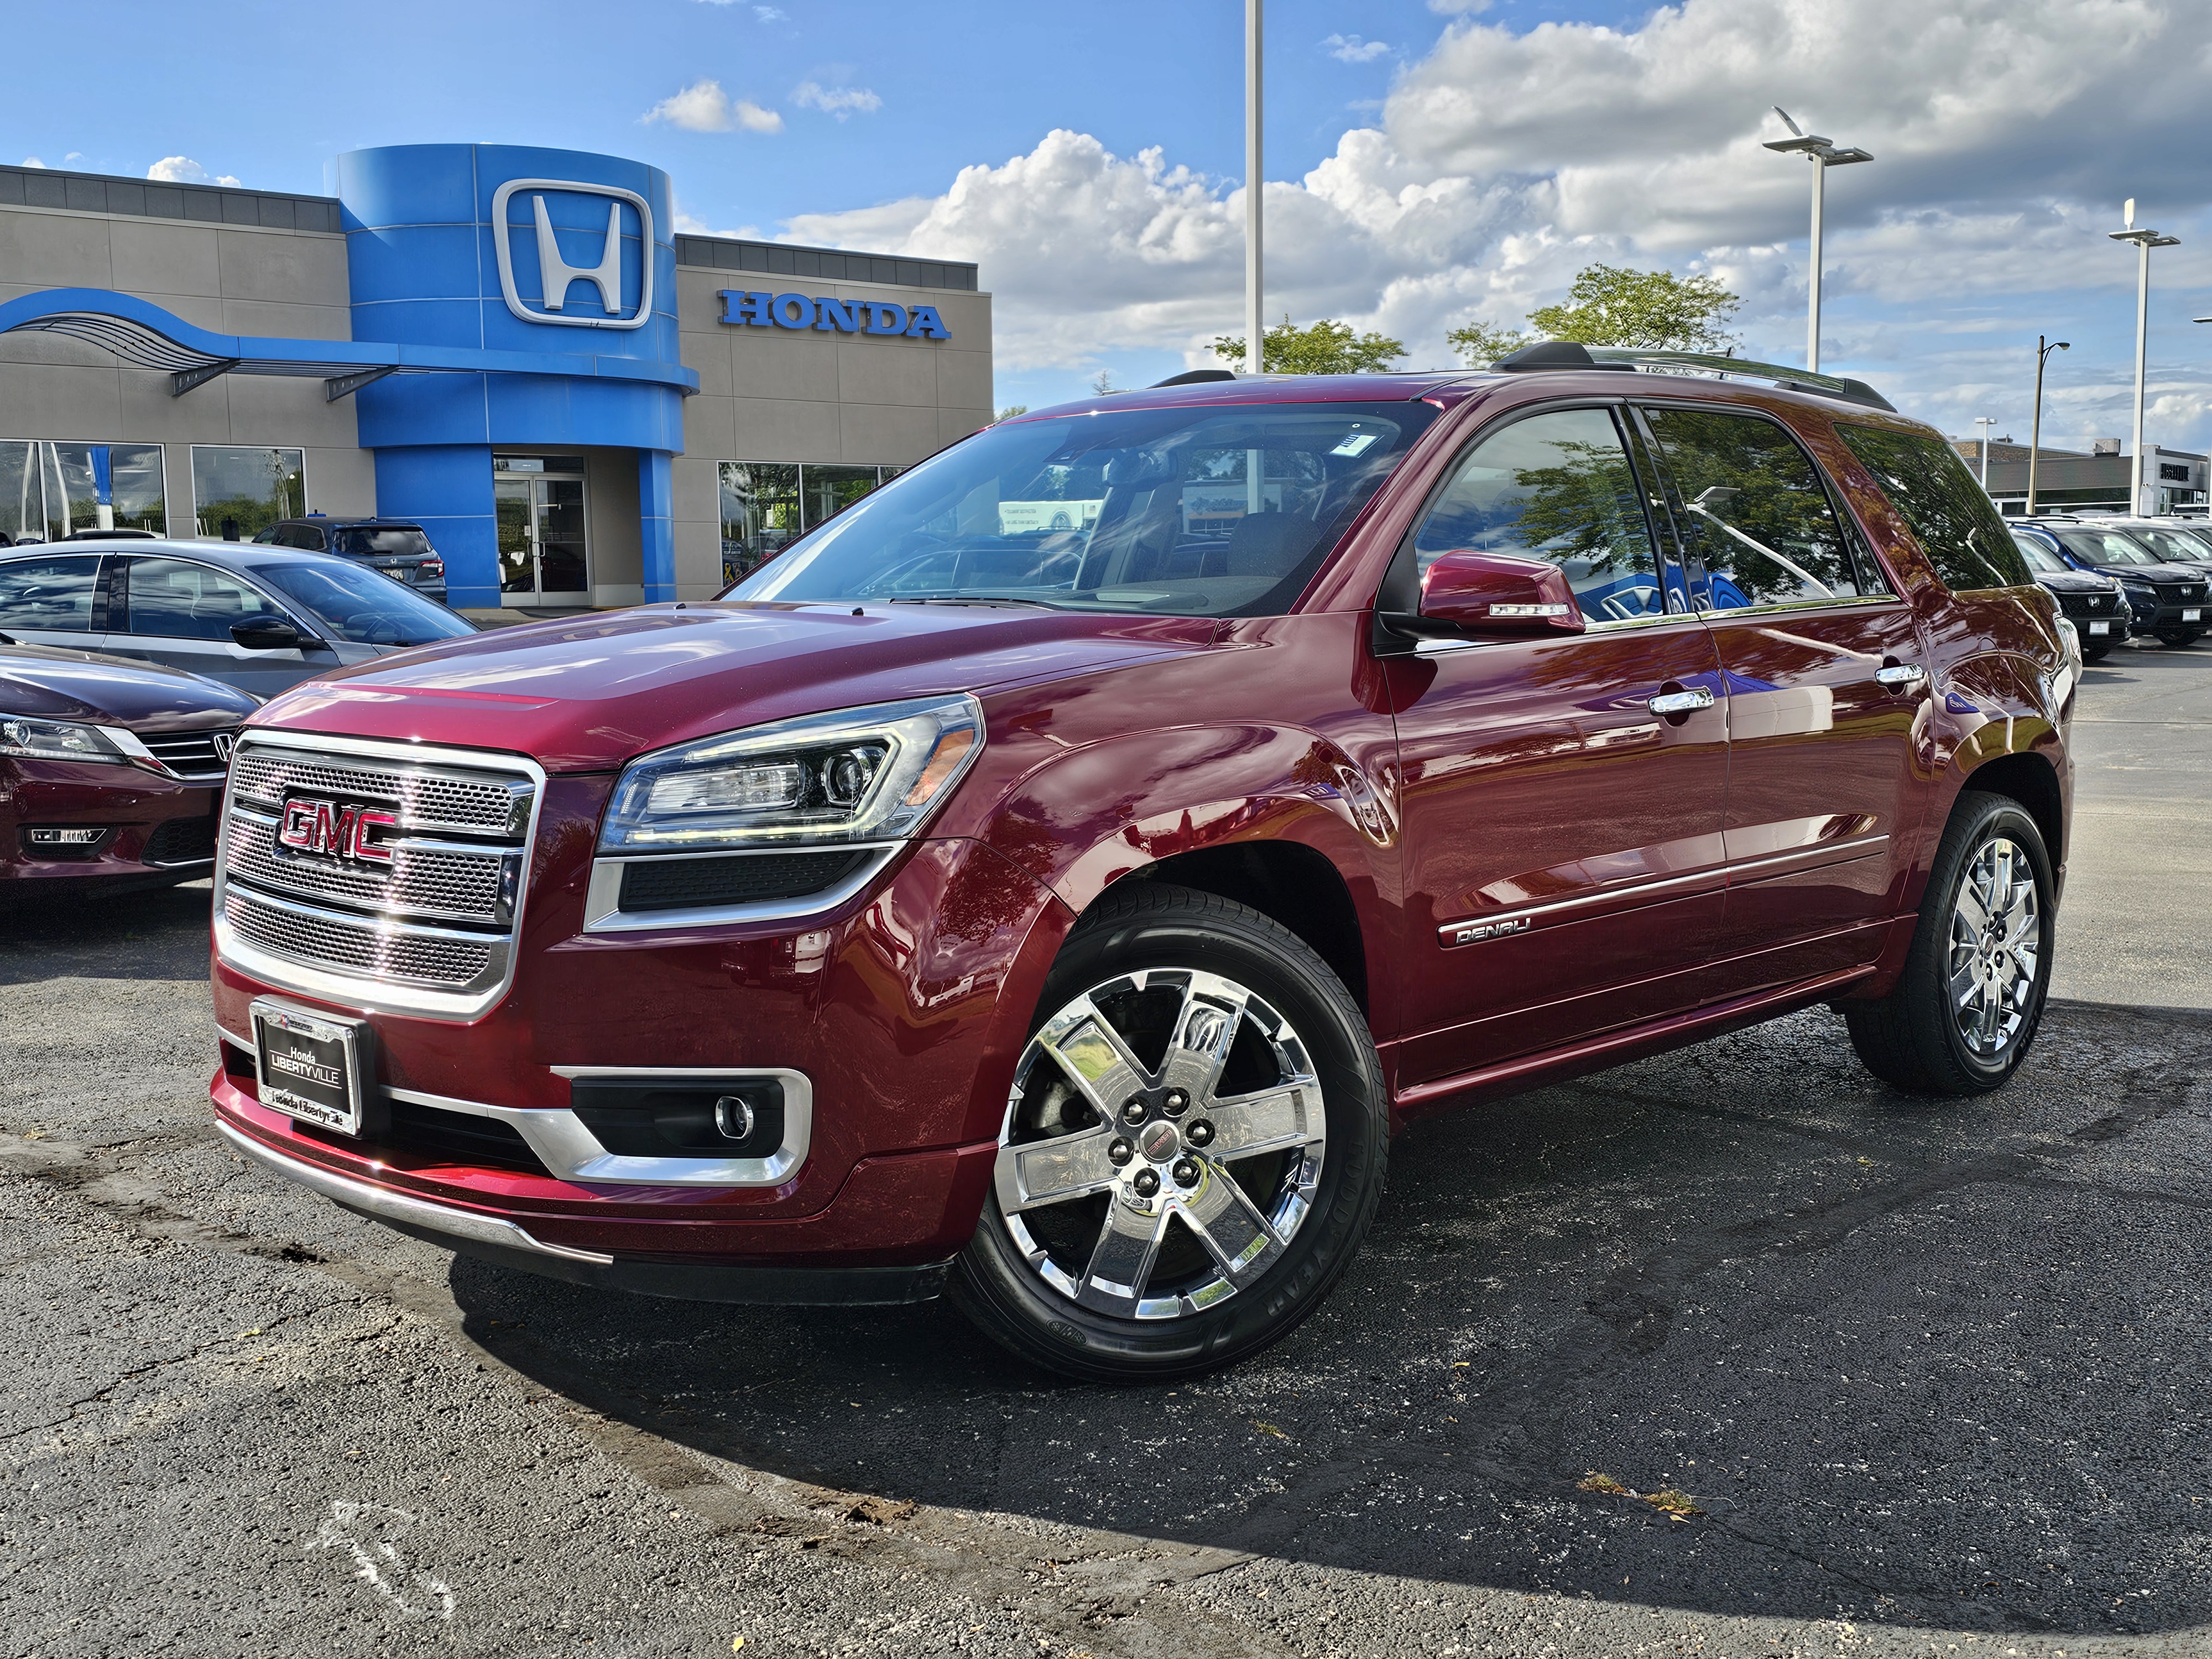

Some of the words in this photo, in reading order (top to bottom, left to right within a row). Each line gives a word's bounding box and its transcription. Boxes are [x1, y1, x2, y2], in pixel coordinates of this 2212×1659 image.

[717, 289, 952, 339] HONDA
[280, 796, 399, 865] GMC
[1456, 917, 1531, 943] DENALI
[272, 1054, 339, 1084] LIBERTYVILLE
[290, 1046, 315, 1064] Honda
[1148, 1129, 1172, 1155] GMC
